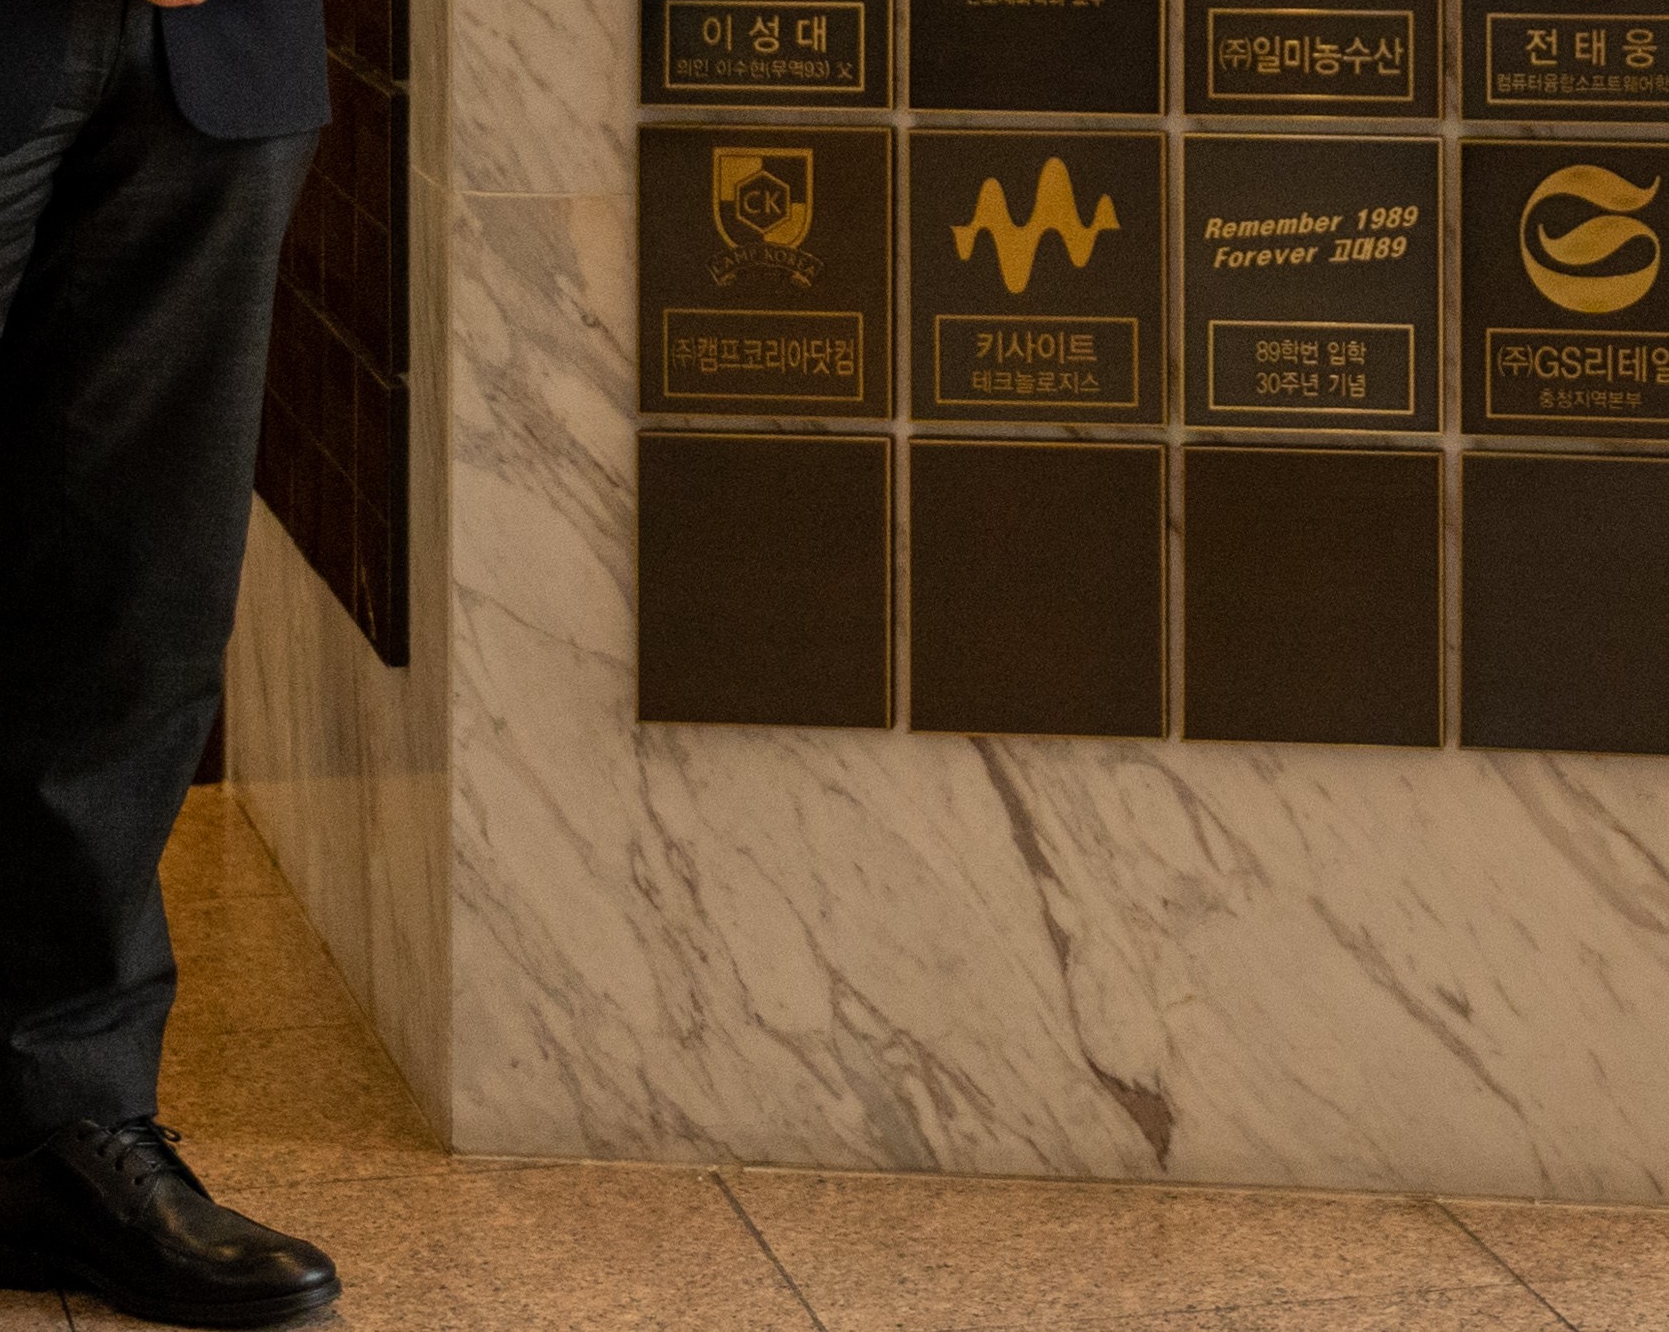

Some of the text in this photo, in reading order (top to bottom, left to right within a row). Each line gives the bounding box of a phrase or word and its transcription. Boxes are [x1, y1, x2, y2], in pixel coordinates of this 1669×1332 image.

[743, 190, 781, 215] CK
[1204, 206, 1418, 240] Remember 1989
[1213, 237, 1407, 269] Forever 고대89
[976, 332, 1097, 364] 키사이트
[1256, 340, 1366, 365] 89학번 입학
[972, 371, 1100, 395] 테크놀로지스
[1256, 373, 1366, 398] 30주년 기념
[1539, 390, 1642, 409] 충청지역본부
